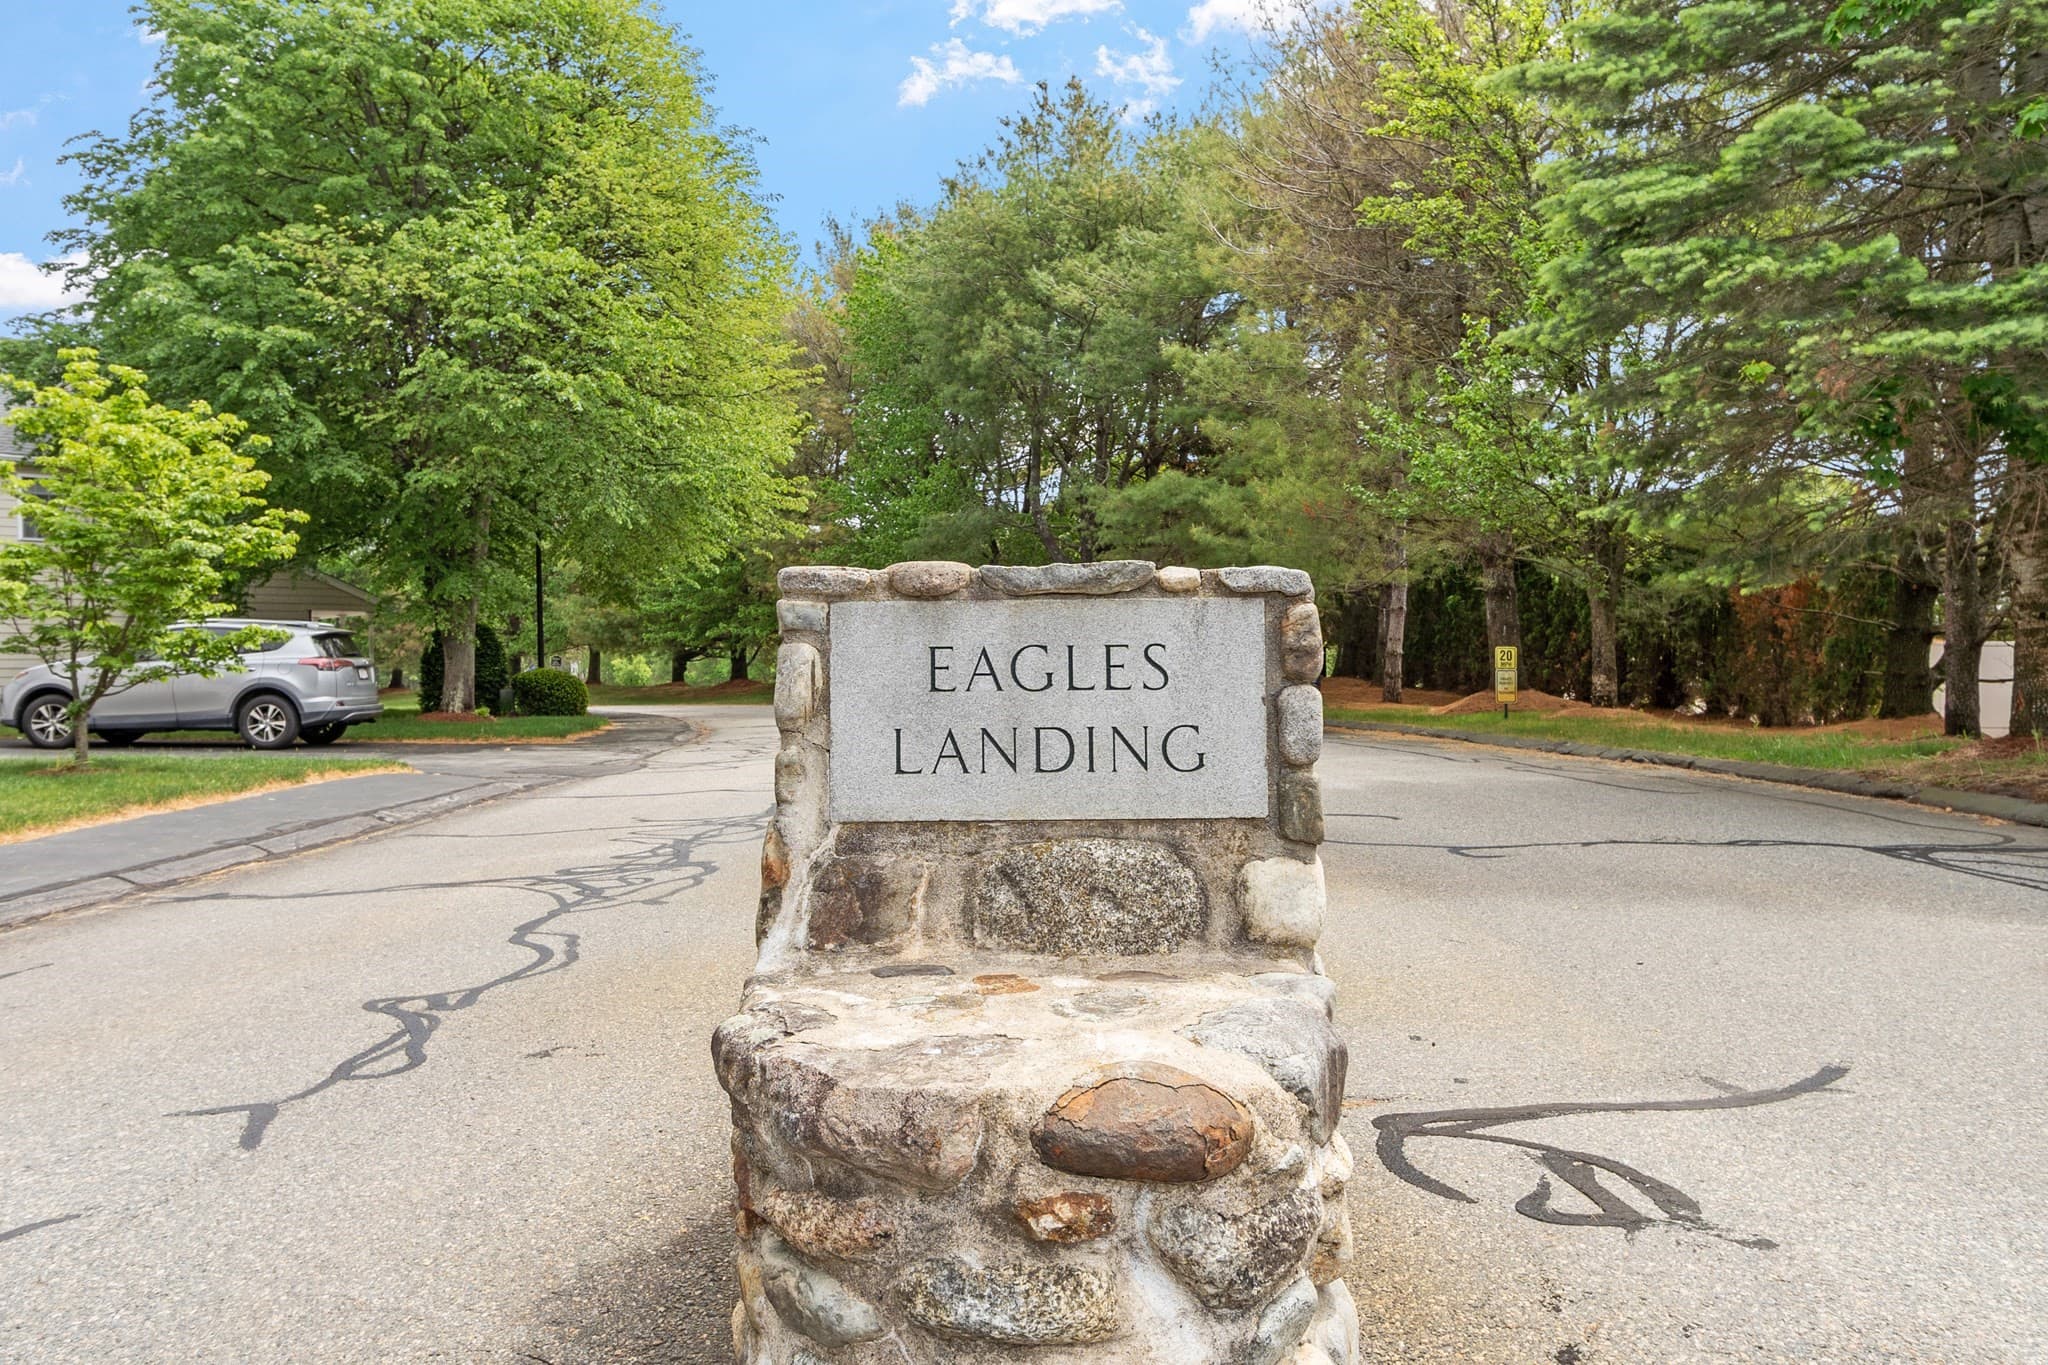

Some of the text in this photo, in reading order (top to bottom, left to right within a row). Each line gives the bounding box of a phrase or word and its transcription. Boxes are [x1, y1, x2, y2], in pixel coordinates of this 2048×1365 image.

[928, 643, 1170, 692] EAGLES
[1499, 650, 1512, 661] 20
[894, 724, 1206, 775] LANDING
